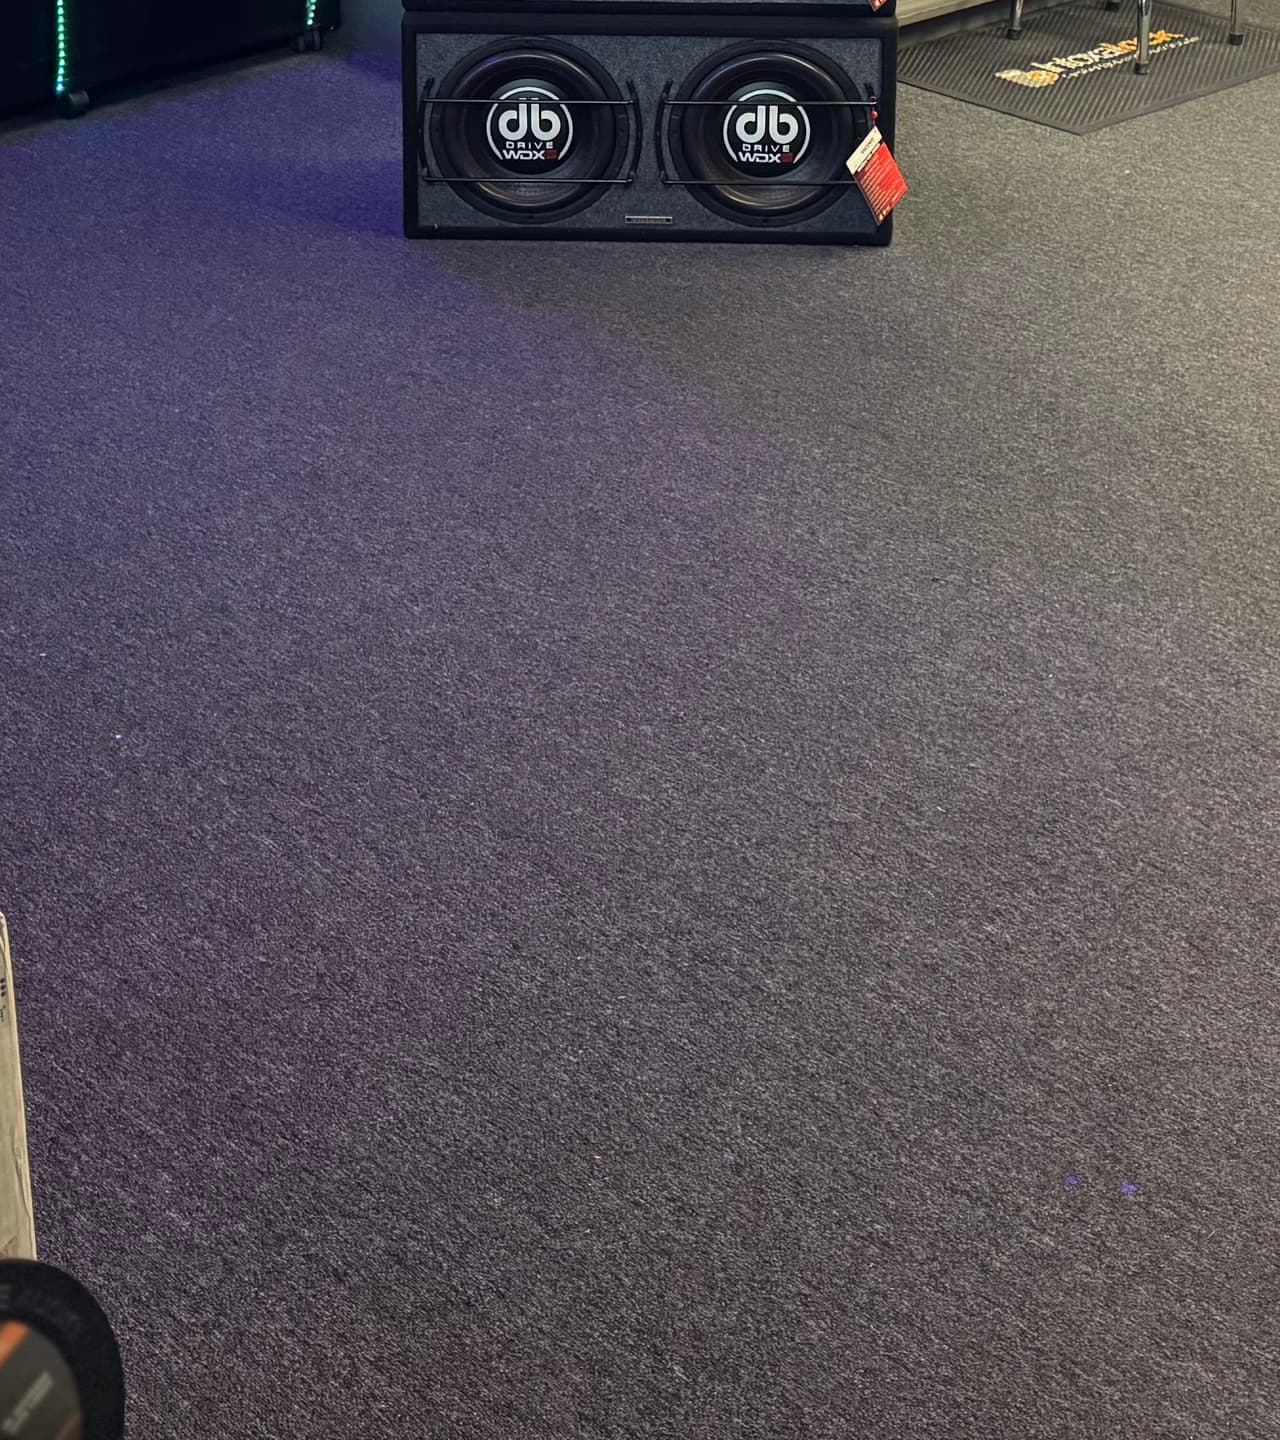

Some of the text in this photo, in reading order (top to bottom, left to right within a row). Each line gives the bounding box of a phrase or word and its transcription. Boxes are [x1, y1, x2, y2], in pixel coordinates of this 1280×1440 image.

[498, 97, 561, 142] db
[735, 104, 799, 144] db
[505, 142, 554, 150] DRIVE
[742, 144, 791, 152] DRIVE
